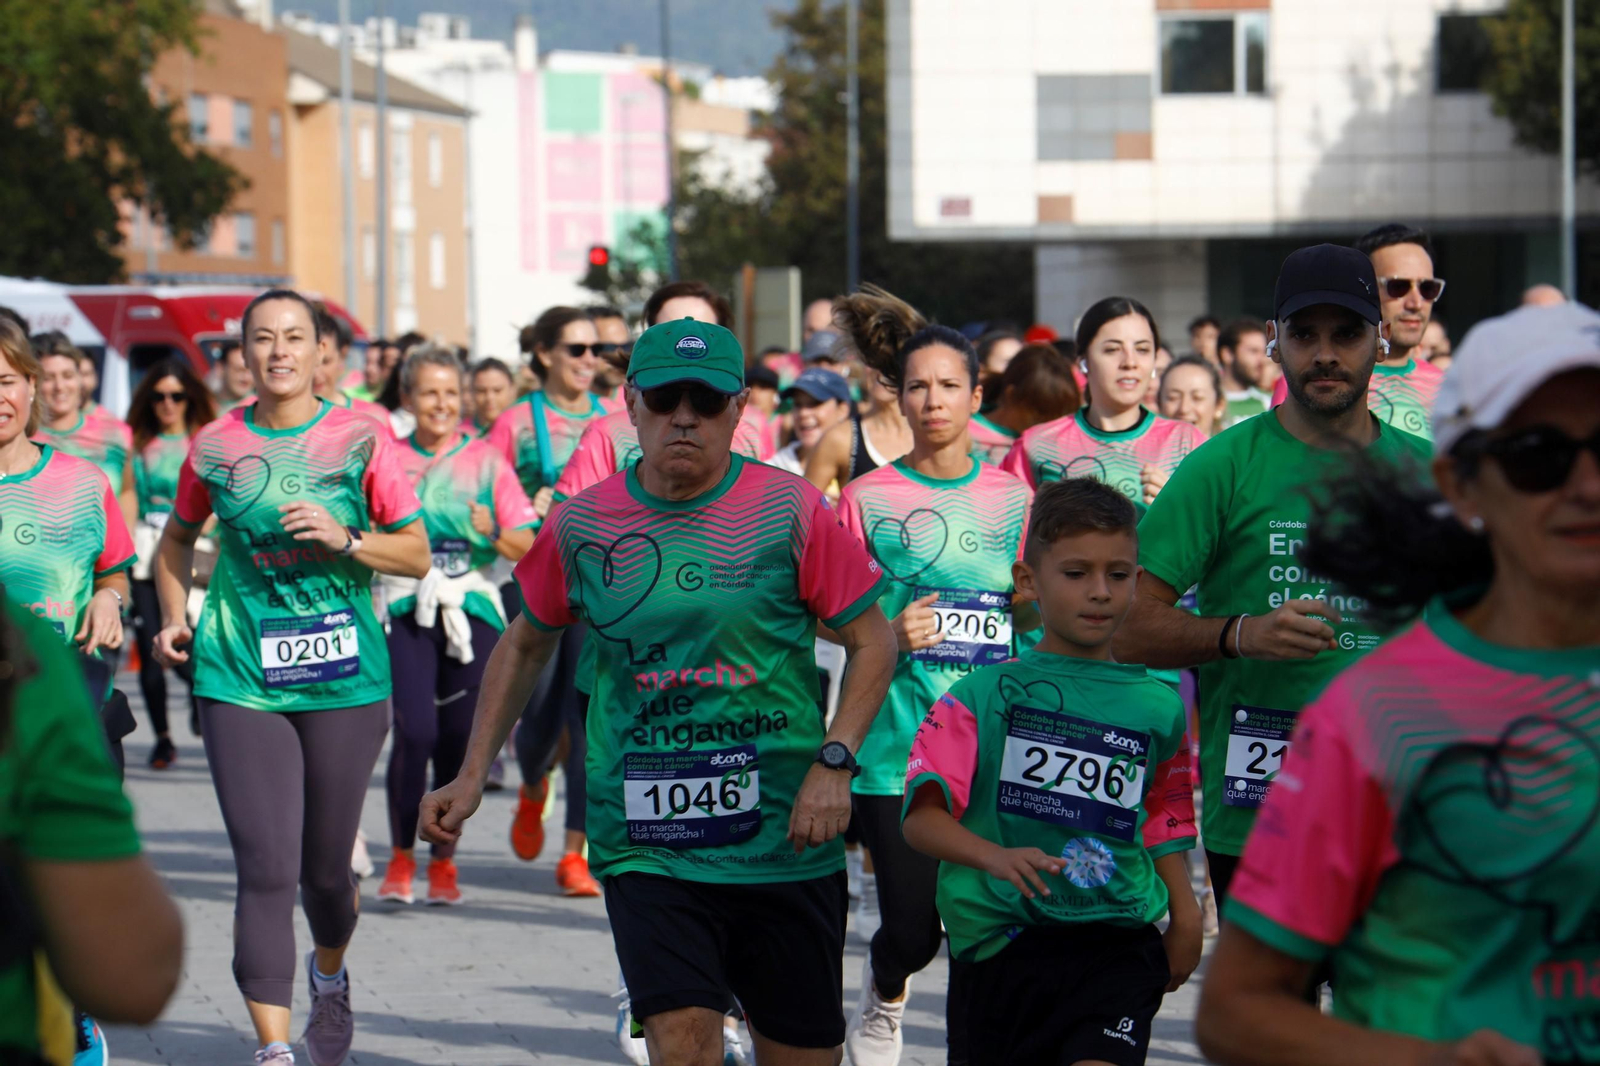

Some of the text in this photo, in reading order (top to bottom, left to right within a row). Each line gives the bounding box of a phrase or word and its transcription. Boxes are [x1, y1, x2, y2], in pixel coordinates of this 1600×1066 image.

[1268, 519, 1307, 529] Córdoba
[709, 563, 785, 572] asociación española
[720, 580, 756, 589] Córdoba
[277, 633, 342, 662] 0201
[628, 638, 668, 666] La
[633, 658, 758, 693] marcha
[633, 694, 694, 725] que
[1271, 714, 1282, 722] en
[630, 708, 788, 752] engancha
[1012, 719, 1087, 740] contra el cáncer
[1013, 710, 1103, 736] Córdoba en marcha
[626, 754, 709, 764] Córdoba en marcha
[664, 762, 695, 770] cáncer
[1246, 741, 1288, 775] 21
[1021, 746, 1126, 799] 2796
[643, 779, 741, 816] 1046
[1007, 786, 1021, 798] La
[1022, 789, 1061, 807] marcha
[1226, 789, 1247, 800] que
[1000, 795, 1021, 807] que
[1023, 799, 1074, 819] engancha
[631, 832, 650, 841] que
[651, 829, 700, 841] engancha
[635, 823, 648, 832] La
[649, 822, 685, 832] marcha
[706, 854, 746, 864] Contra
[747, 853, 760, 863] el
[761, 852, 797, 863] Cáncer
[1103, 1028, 1122, 1039] TEAM
